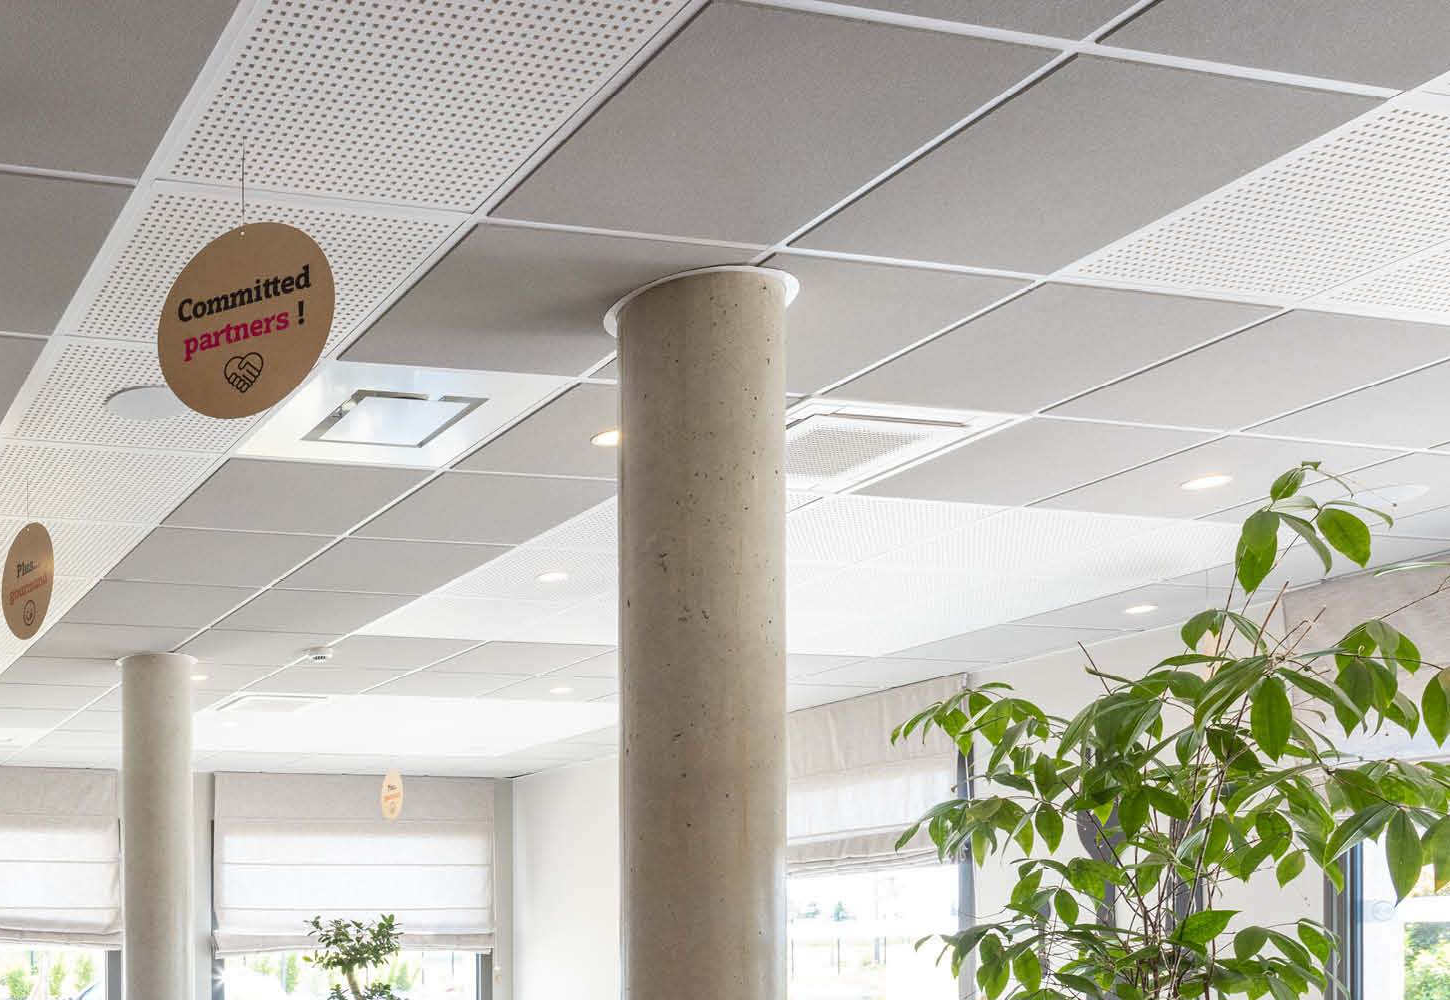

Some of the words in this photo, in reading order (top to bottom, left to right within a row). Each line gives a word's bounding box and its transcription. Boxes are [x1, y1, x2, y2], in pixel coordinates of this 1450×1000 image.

[177, 263, 313, 323] Committed
[183, 311, 291, 363] partners
[297, 299, 305, 326] !
